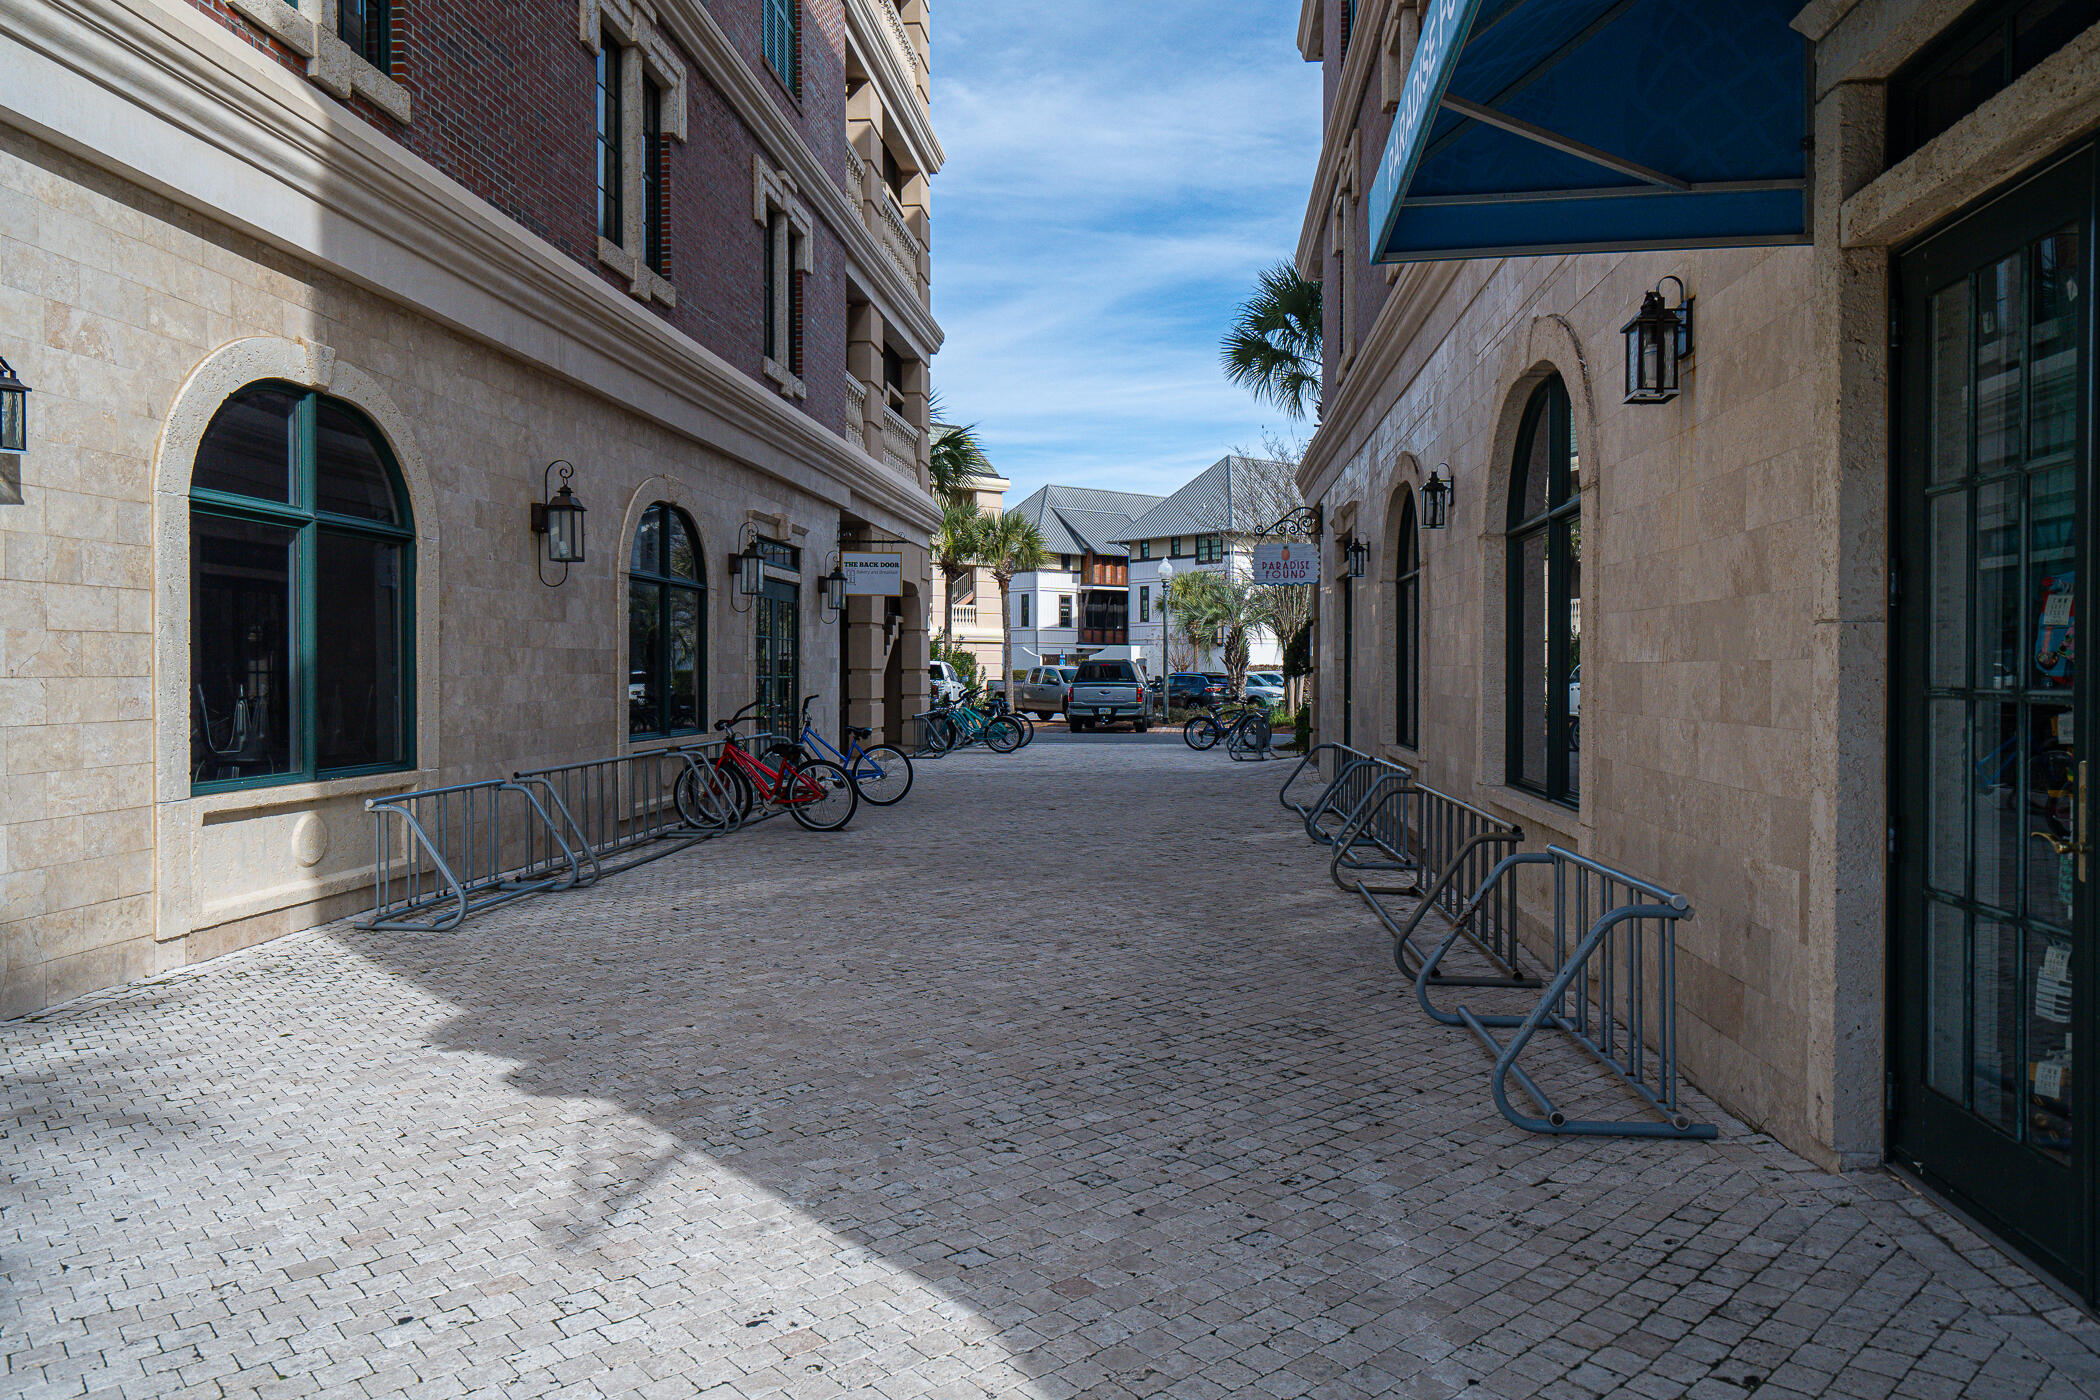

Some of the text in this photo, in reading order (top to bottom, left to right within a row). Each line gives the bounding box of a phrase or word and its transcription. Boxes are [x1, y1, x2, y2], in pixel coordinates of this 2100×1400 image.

[1388, 15, 1437, 193] PARADISE
[1262, 560, 1310, 570] PARADISE
[1265, 569, 1306, 579] FOUND
